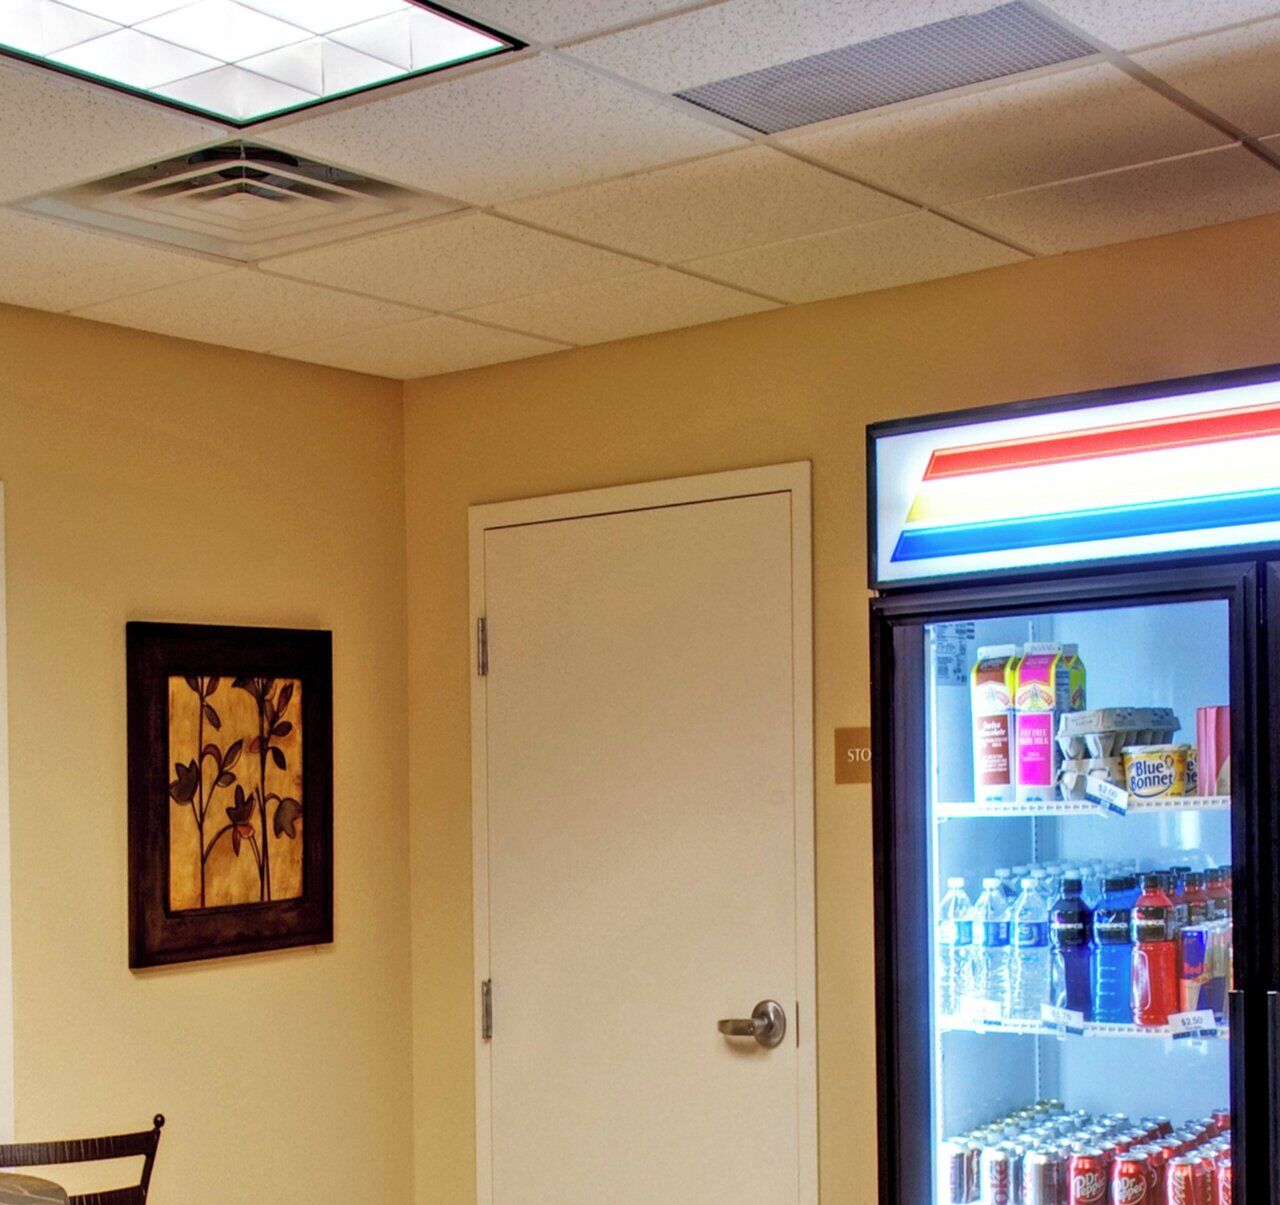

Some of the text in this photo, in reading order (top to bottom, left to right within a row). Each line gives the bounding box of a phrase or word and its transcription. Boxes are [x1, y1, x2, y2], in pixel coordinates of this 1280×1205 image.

[1135, 761, 1164, 776] Blue
[1130, 773, 1173, 792] Bonnet
[1181, 1016, 1203, 1026] $2.50
